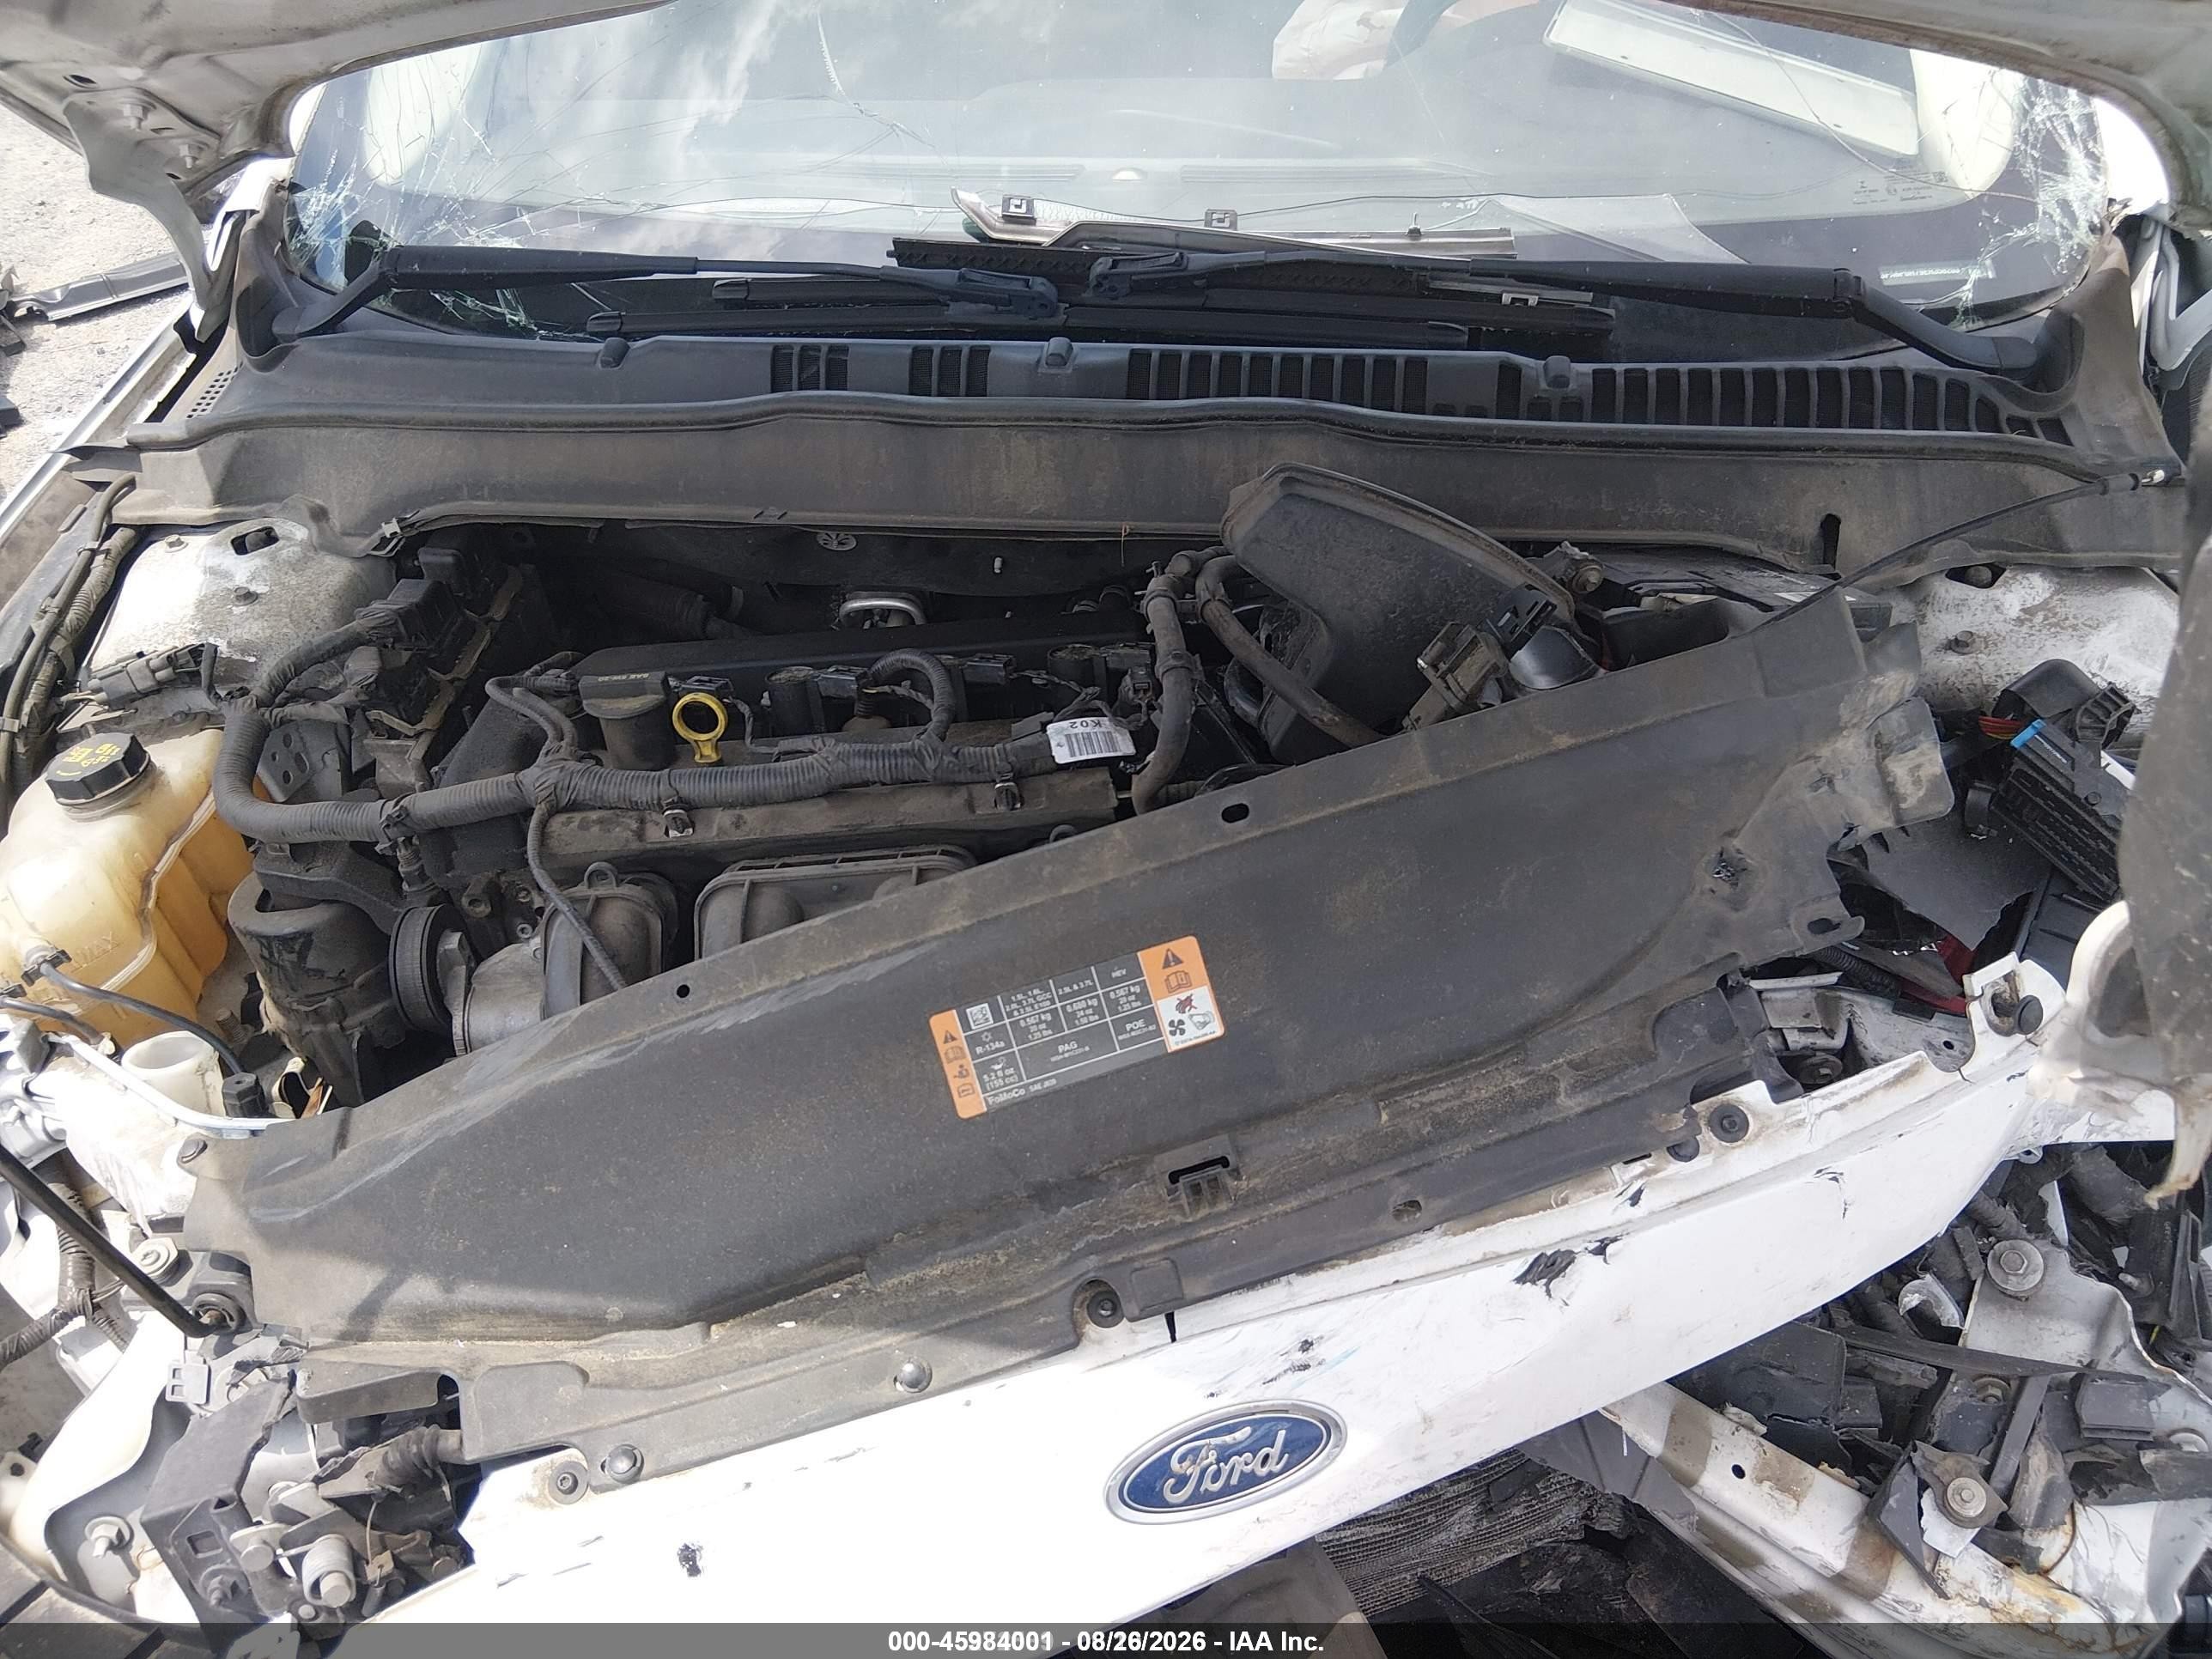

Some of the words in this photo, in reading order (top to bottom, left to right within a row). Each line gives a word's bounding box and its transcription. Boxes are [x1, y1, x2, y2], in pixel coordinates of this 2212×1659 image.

[1069, 720, 1103, 729] K02
[1129, 985, 1141, 994] kg
[1086, 998, 1098, 1007] kg
[1040, 1012, 1052, 1022] kg
[1125, 1018, 1146, 1031] POE
[975, 1040, 1006, 1055] R-134a
[1058, 1041, 1078, 1054] PAG
[985, 1078, 1004, 1091] (155
[988, 1088, 1026, 1106] FoMoCo
[1163, 1425, 1290, 1504] Ford
